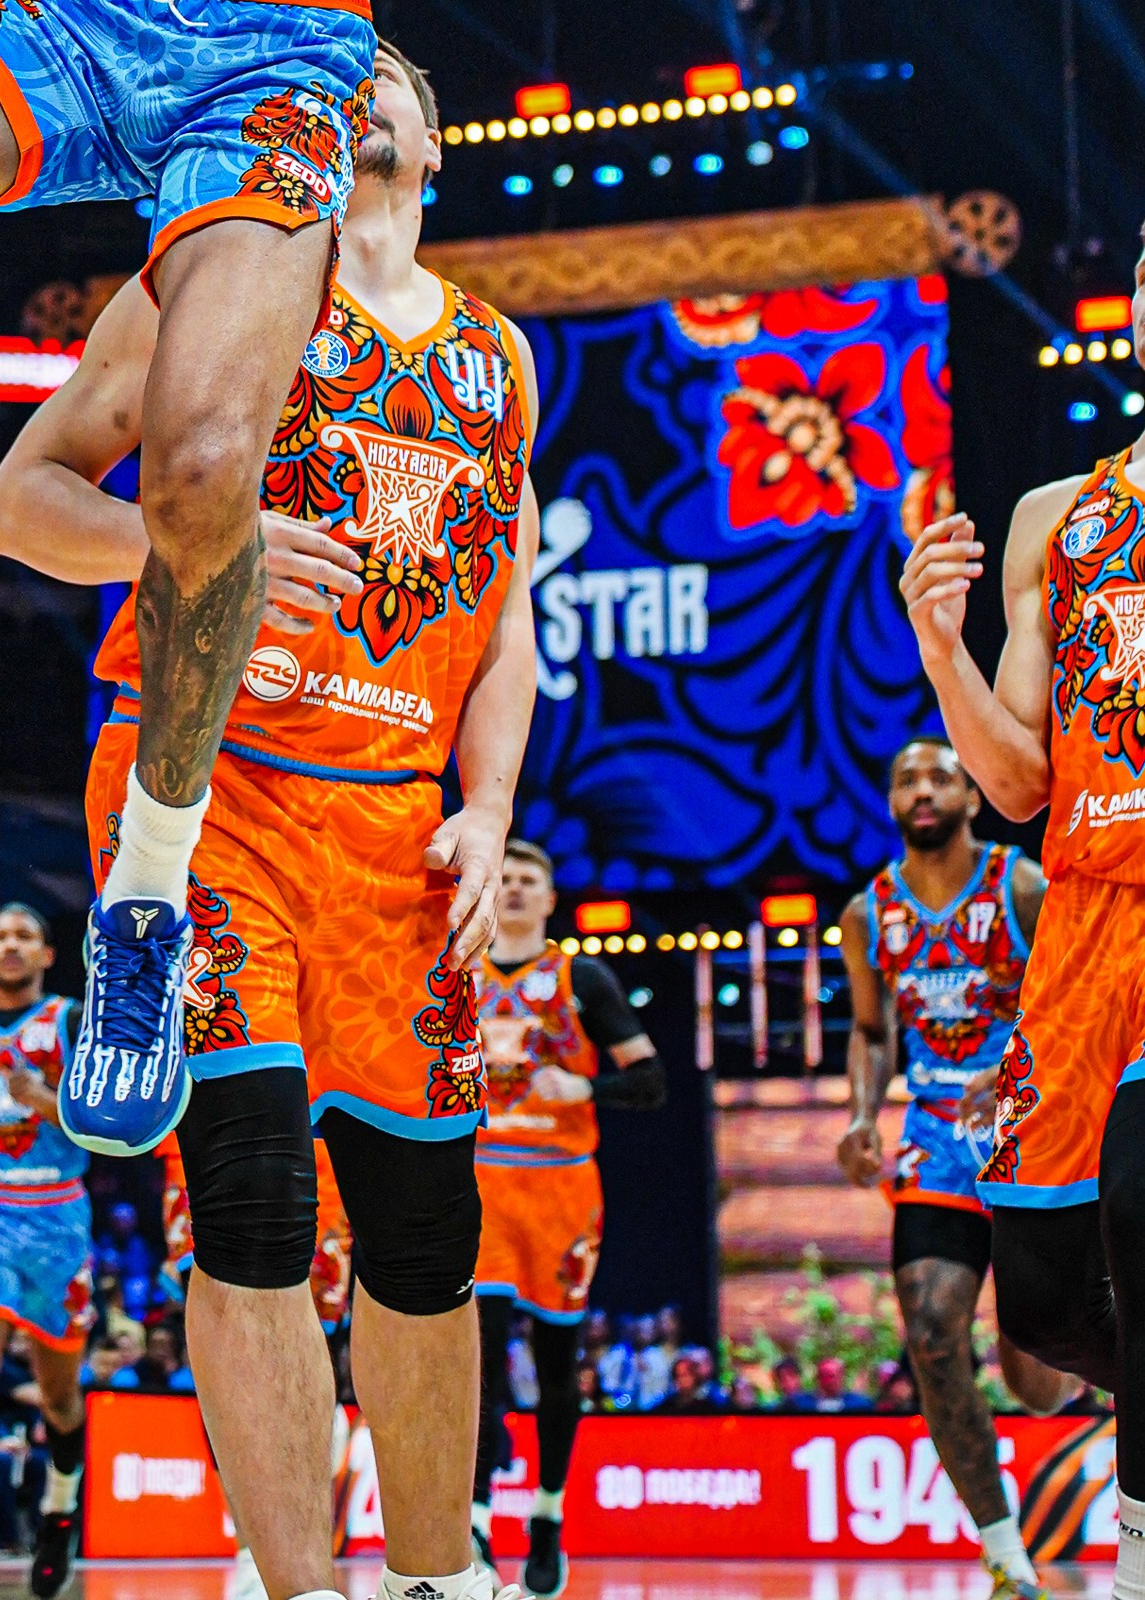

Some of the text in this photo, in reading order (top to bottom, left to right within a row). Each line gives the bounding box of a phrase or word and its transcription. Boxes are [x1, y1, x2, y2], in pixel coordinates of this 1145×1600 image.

[274, 153, 328, 197] ZEDO
[367, 441, 448, 482] HOZYAEVA
[539, 563, 709, 663] STAR
[303, 670, 434, 724] КАМКАБЕЛЬ
[791, 1435, 1019, 1546] 194
